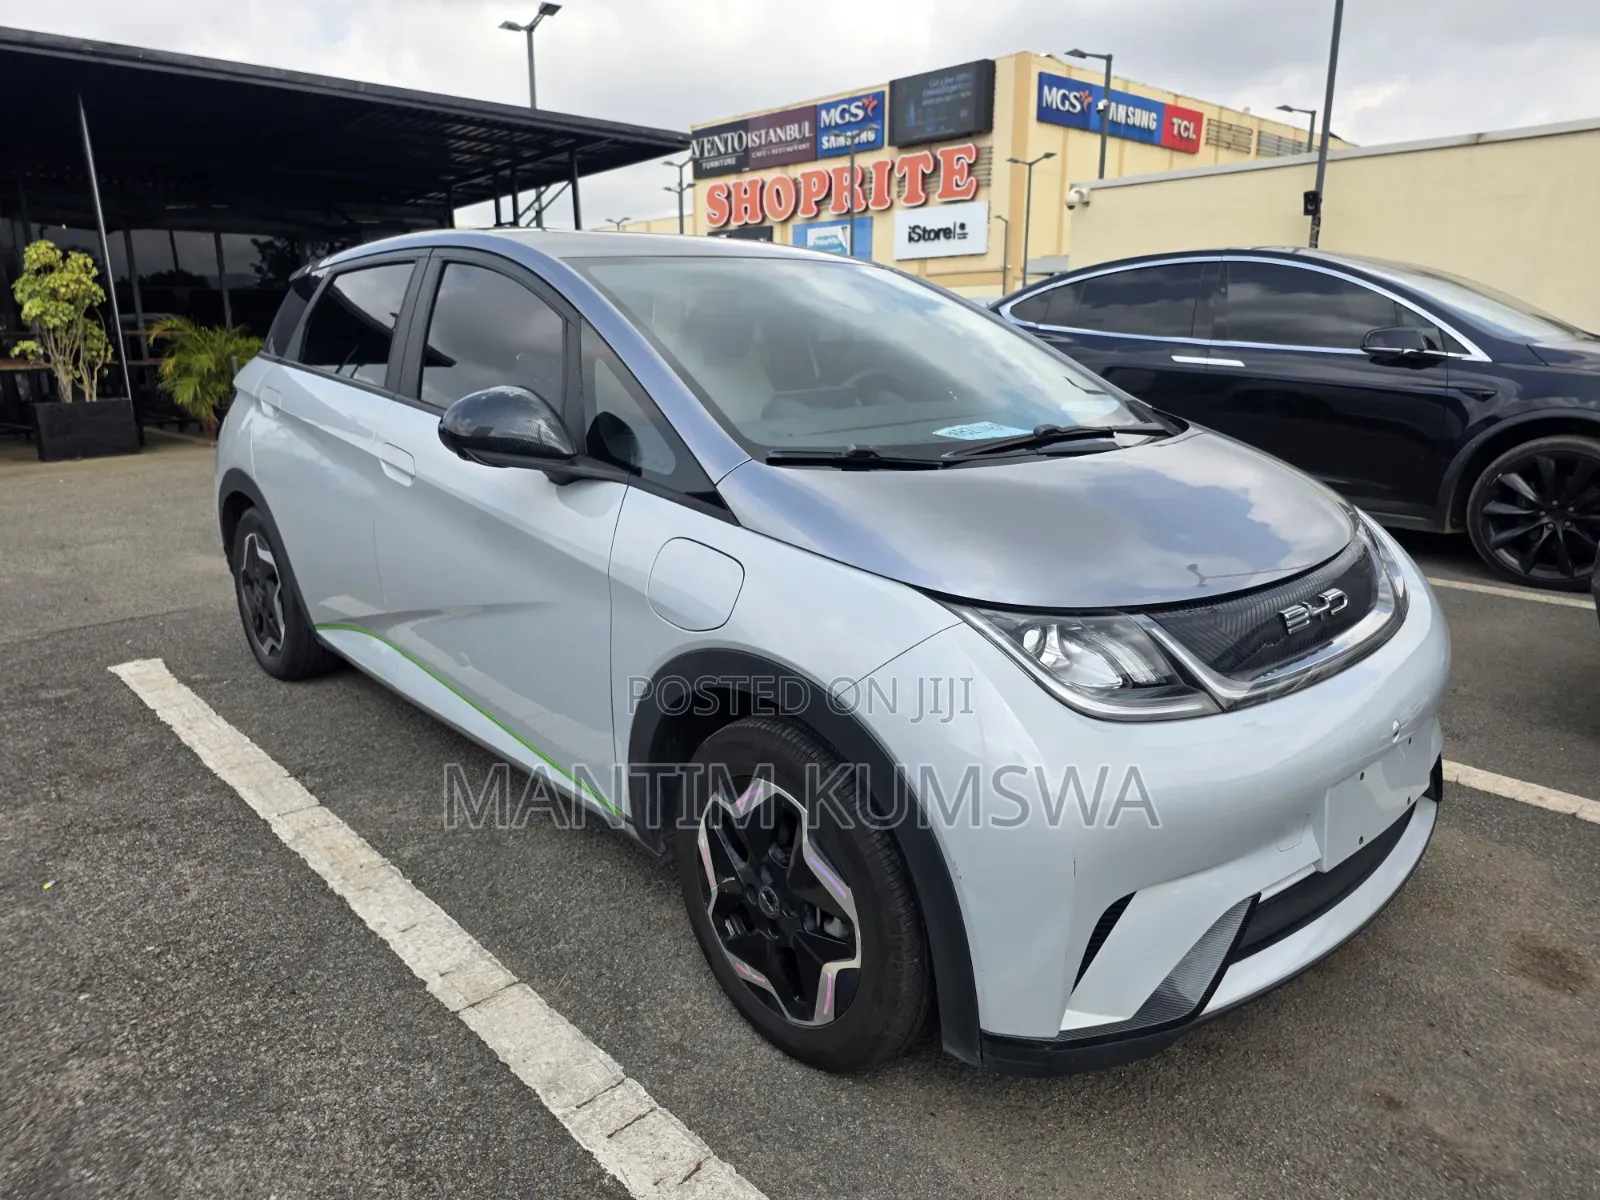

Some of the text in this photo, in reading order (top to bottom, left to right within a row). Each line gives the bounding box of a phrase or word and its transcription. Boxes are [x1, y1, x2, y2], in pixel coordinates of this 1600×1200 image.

[1042, 84, 1082, 114] MGS
[820, 101, 865, 128] MGS
[1102, 100, 1157, 131] AMSUNG
[747, 121, 814, 148] ISTANBUL
[1171, 117, 1197, 140] TCL
[702, 156, 736, 170] FURNITURE
[705, 143, 979, 228] SHOPRITE
[908, 225, 952, 243] iStore
[1279, 588, 1348, 635] BYD
